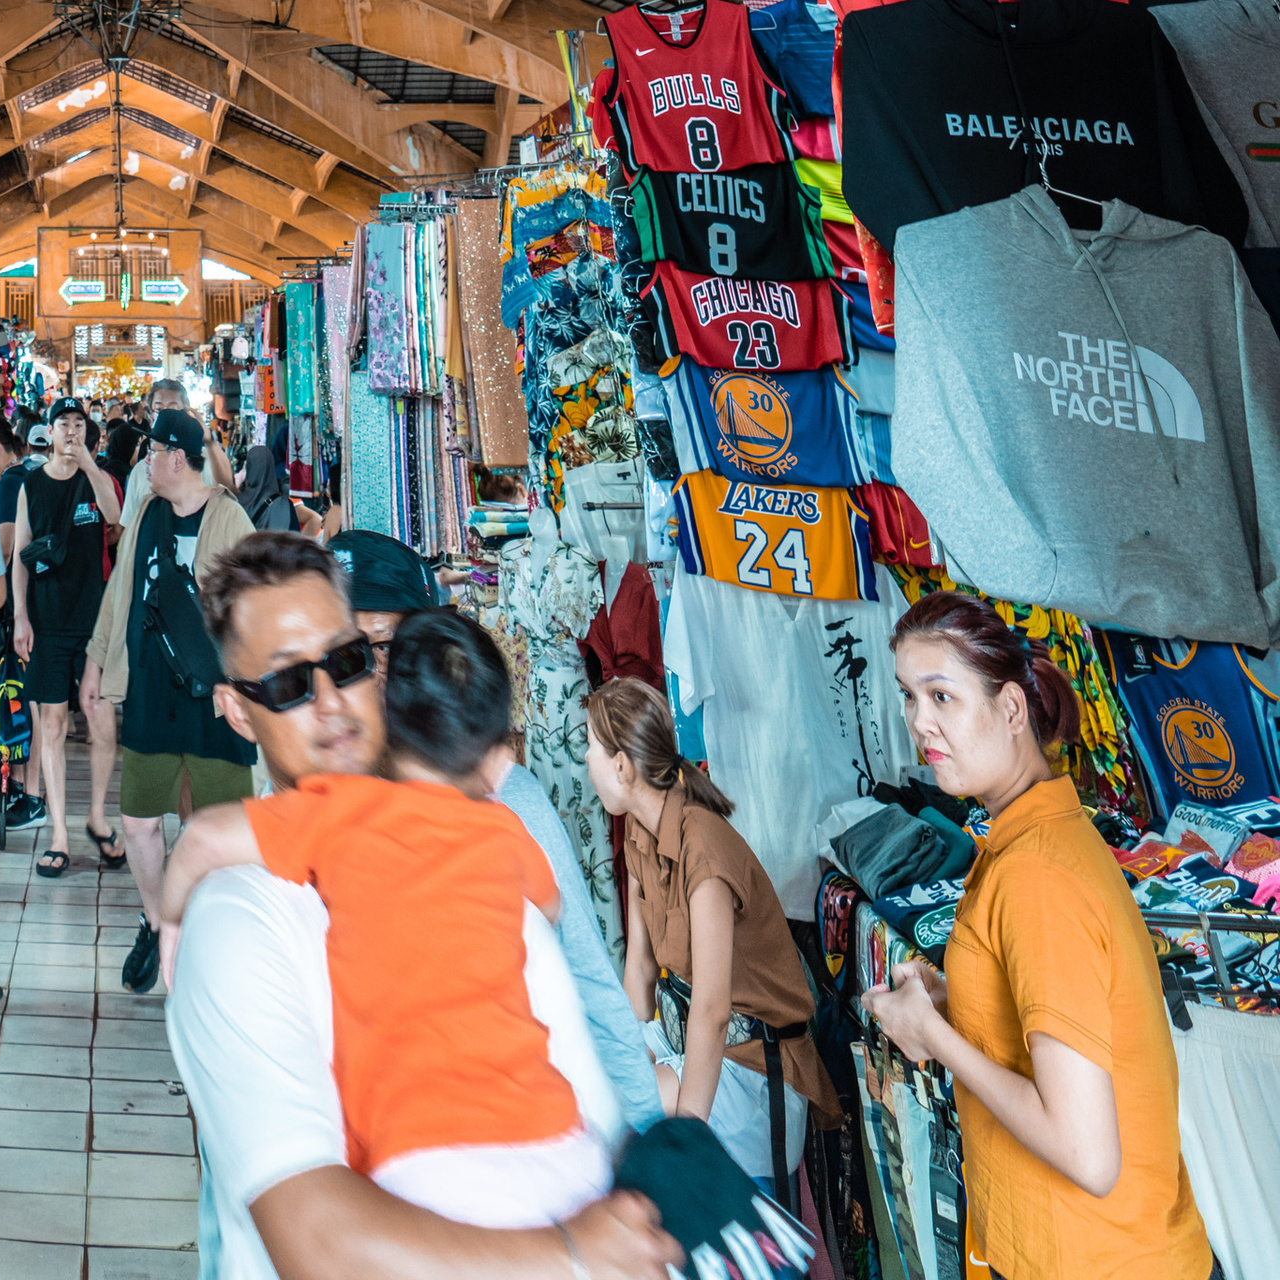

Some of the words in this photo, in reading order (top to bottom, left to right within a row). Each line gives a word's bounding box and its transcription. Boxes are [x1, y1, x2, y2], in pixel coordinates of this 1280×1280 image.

[648, 73, 742, 117] BULLS
[685, 117, 723, 172] 8
[676, 173, 766, 223] CELTICS
[708, 222, 738, 276] 8
[691, 277, 801, 327] CHICAGO
[726, 320, 781, 369] 23
[1058, 331, 1131, 371] THE
[1013, 352, 1133, 400] NORTH
[747, 390, 773, 413] 30
[1049, 387, 1137, 431] FACE
[716, 439, 799, 478] WARRIORS
[717, 481, 822, 525] LAKERS
[734, 518, 814, 596] 24
[1156, 697, 1191, 722] GOLDEN
[1194, 698, 1226, 726] STATE
[1191, 720, 1215, 740] 30
[1174, 771, 1245, 800] WARRIORS
[1174, 805, 1202, 825] Good
